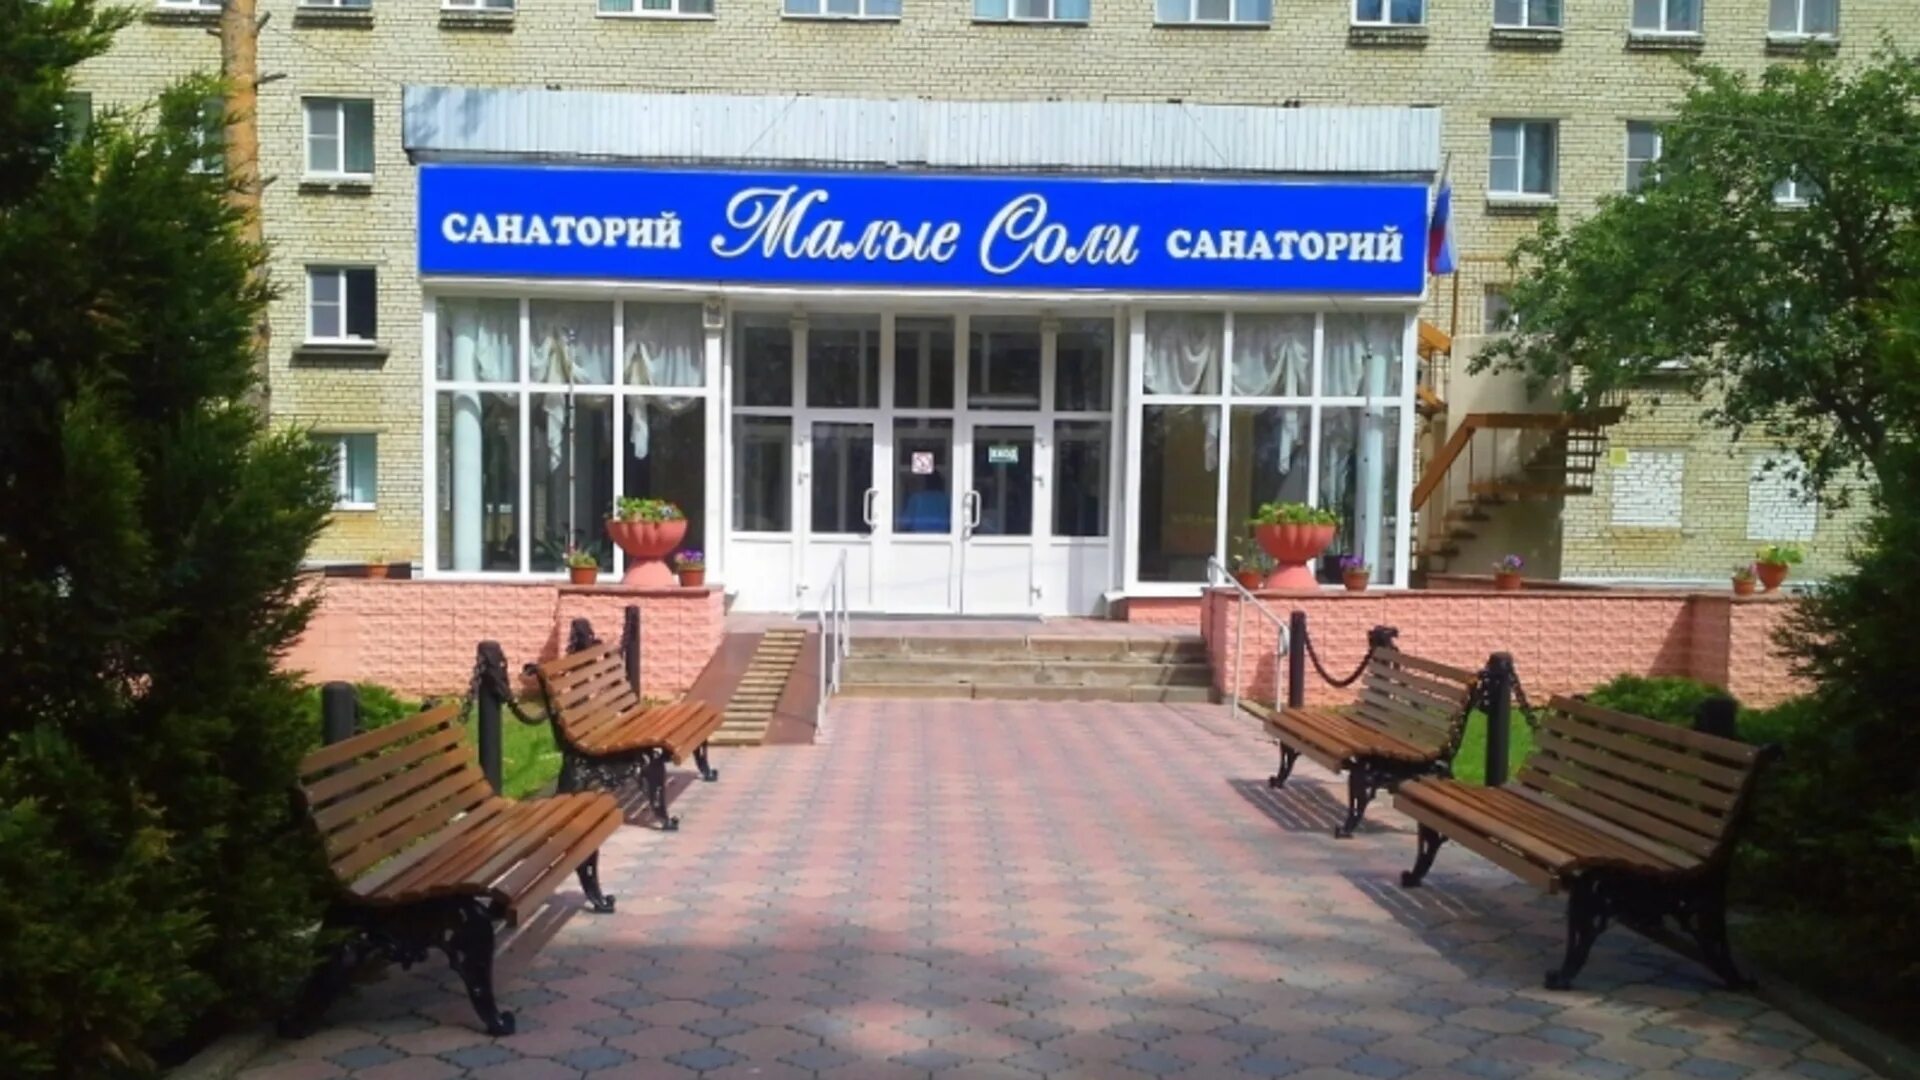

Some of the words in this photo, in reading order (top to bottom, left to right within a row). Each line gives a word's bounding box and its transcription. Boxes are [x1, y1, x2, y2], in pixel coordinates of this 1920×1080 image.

[442, 212, 682, 249] САНАТОРИЙ
[711, 185, 960, 262] Малые
[980, 193, 1139, 274] Соли
[1166, 226, 1403, 262] САНАТОРИЙ
